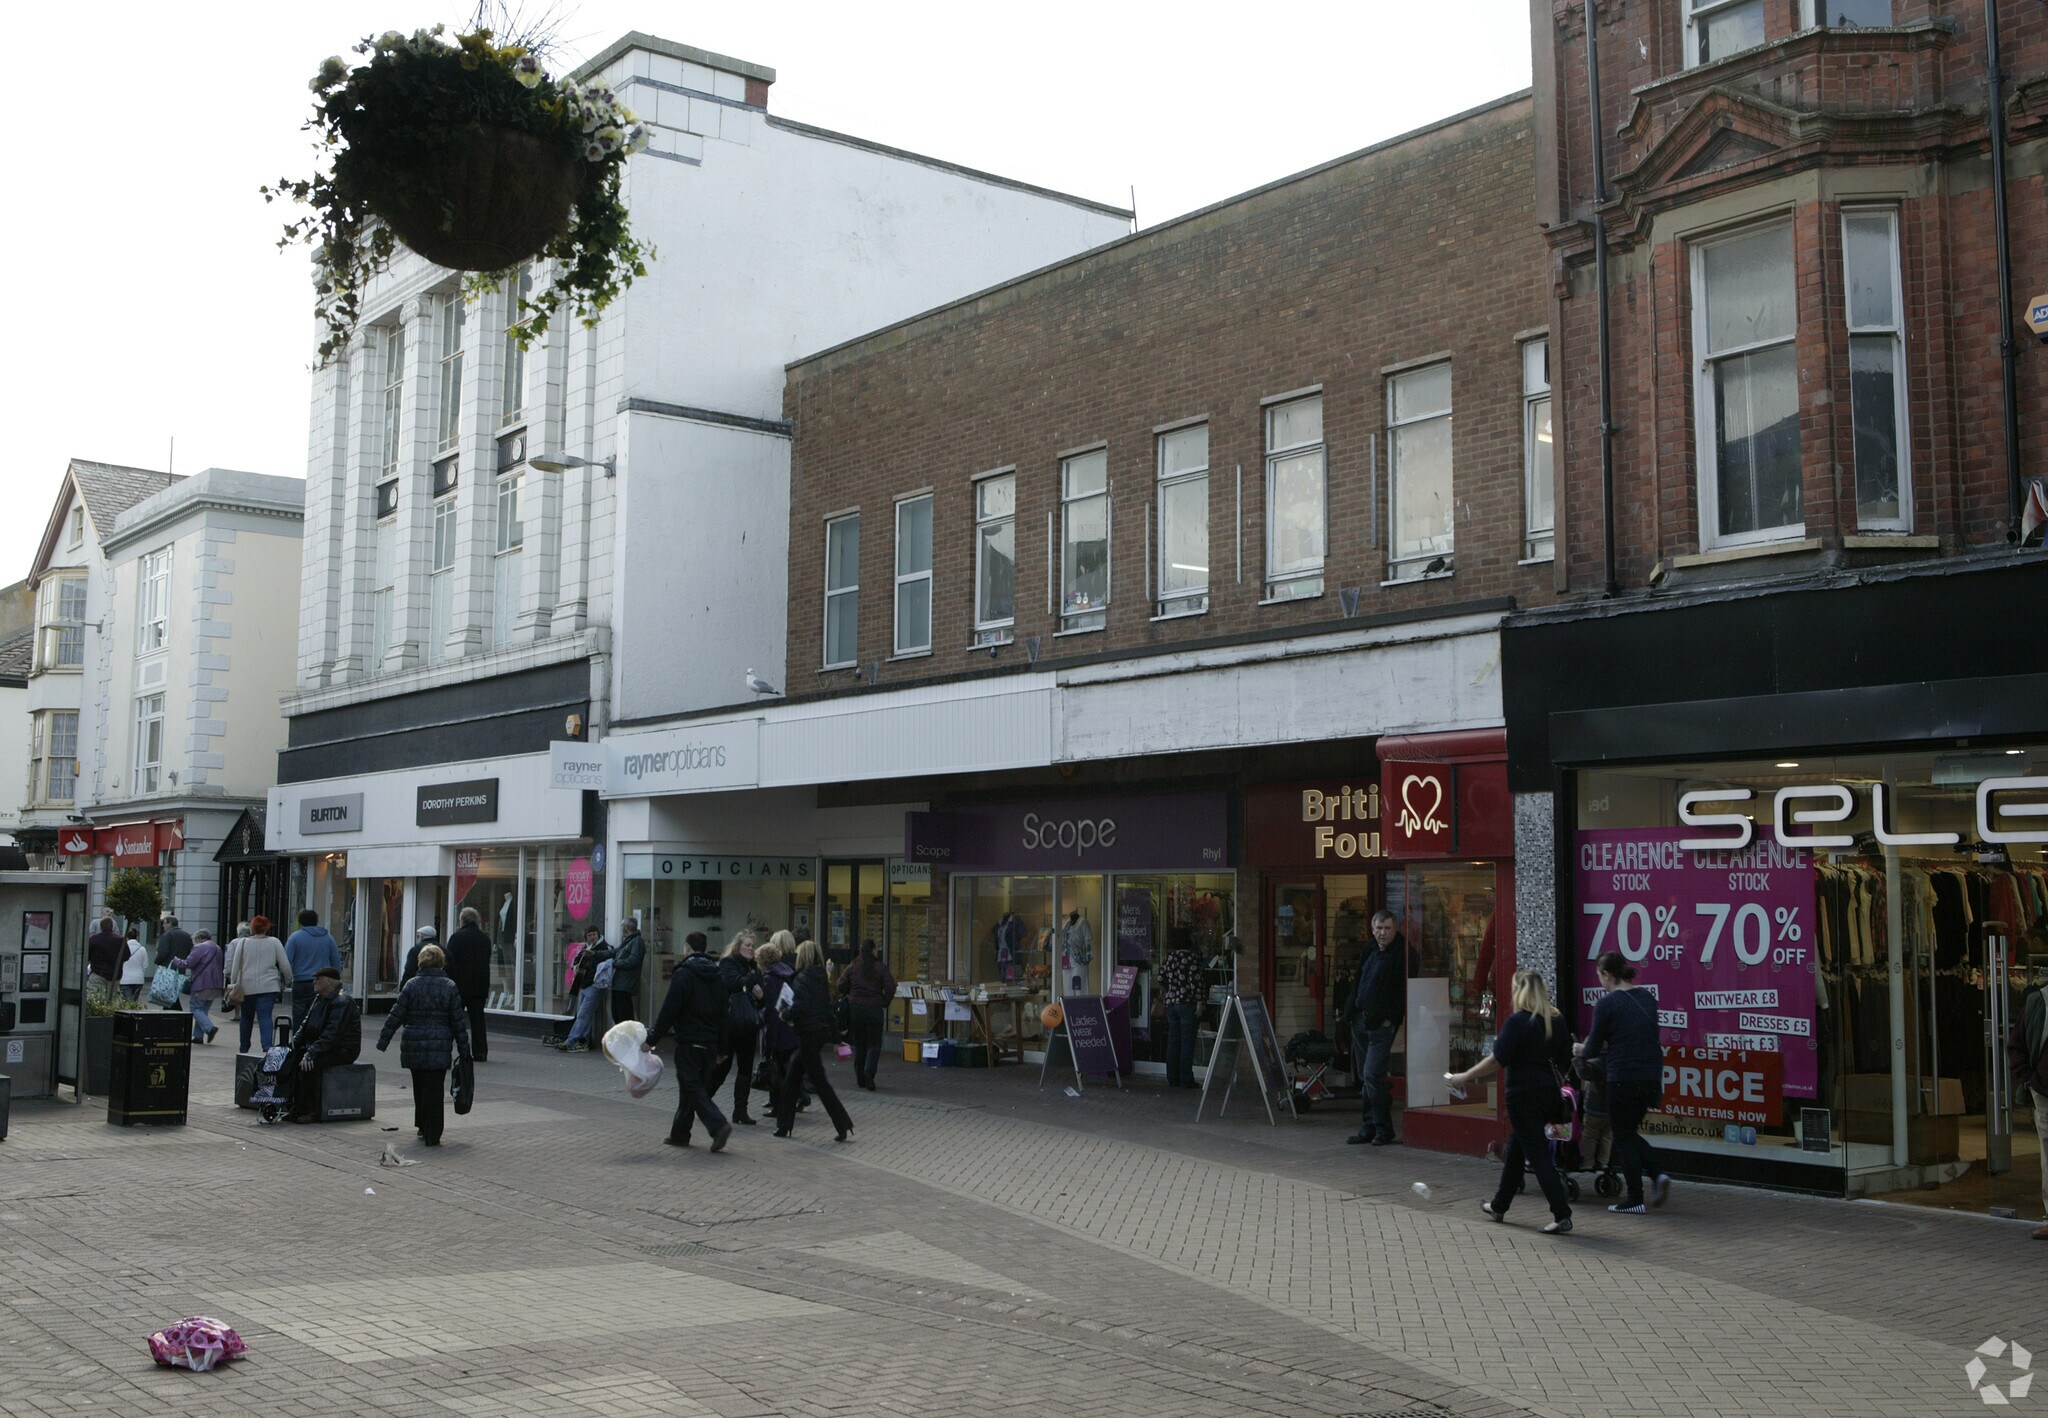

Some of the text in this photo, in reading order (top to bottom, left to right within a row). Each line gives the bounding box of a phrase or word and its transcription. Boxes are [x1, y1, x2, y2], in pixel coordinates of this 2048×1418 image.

[563, 761, 602, 774] rayner
[422, 794, 487, 810] DOROTHY PERKINS
[1302, 783, 1383, 822] Briti
[310, 805, 347, 823] BURTON
[1022, 812, 1117, 857] Scope
[1315, 826, 1389, 859] Fou
[123, 835, 152, 856] Santander
[915, 844, 951, 859] Scope
[457, 852, 478, 868] SALE
[1203, 847, 1221, 862] Rhyl
[1581, 840, 1808, 871] CLEARENCE CLEARENCE
[662, 860, 808, 876] OPTICIANS
[568, 870, 590, 883] TODAY
[1612, 872, 1770, 891] STOCK STOCK
[1653, 945, 1684, 961] OFF
[1773, 947, 1807, 966] OFF
[1696, 991, 1776, 1006] KNITWEAR £8
[1069, 1014, 1098, 1027] Ladies
[1672, 1013, 1685, 1026] £5
[1741, 1015, 1808, 1033] DRESSES £5
[1072, 1027, 1092, 1037] wear
[1075, 1035, 1107, 1048] needed
[1709, 1034, 1775, 1051] T-Shirt £3
[144, 1047, 176, 1056] LITTER
[1677, 1047, 1686, 1058] 1
[1693, 1049, 1732, 1062] GET
[1739, 1051, 1747, 1063] 1
[1661, 1065, 1765, 1103] PRICE
[1665, 1104, 1695, 1117] SALE
[1698, 1107, 1735, 1120] ITEMS
[1738, 1110, 1767, 1123] NOW
